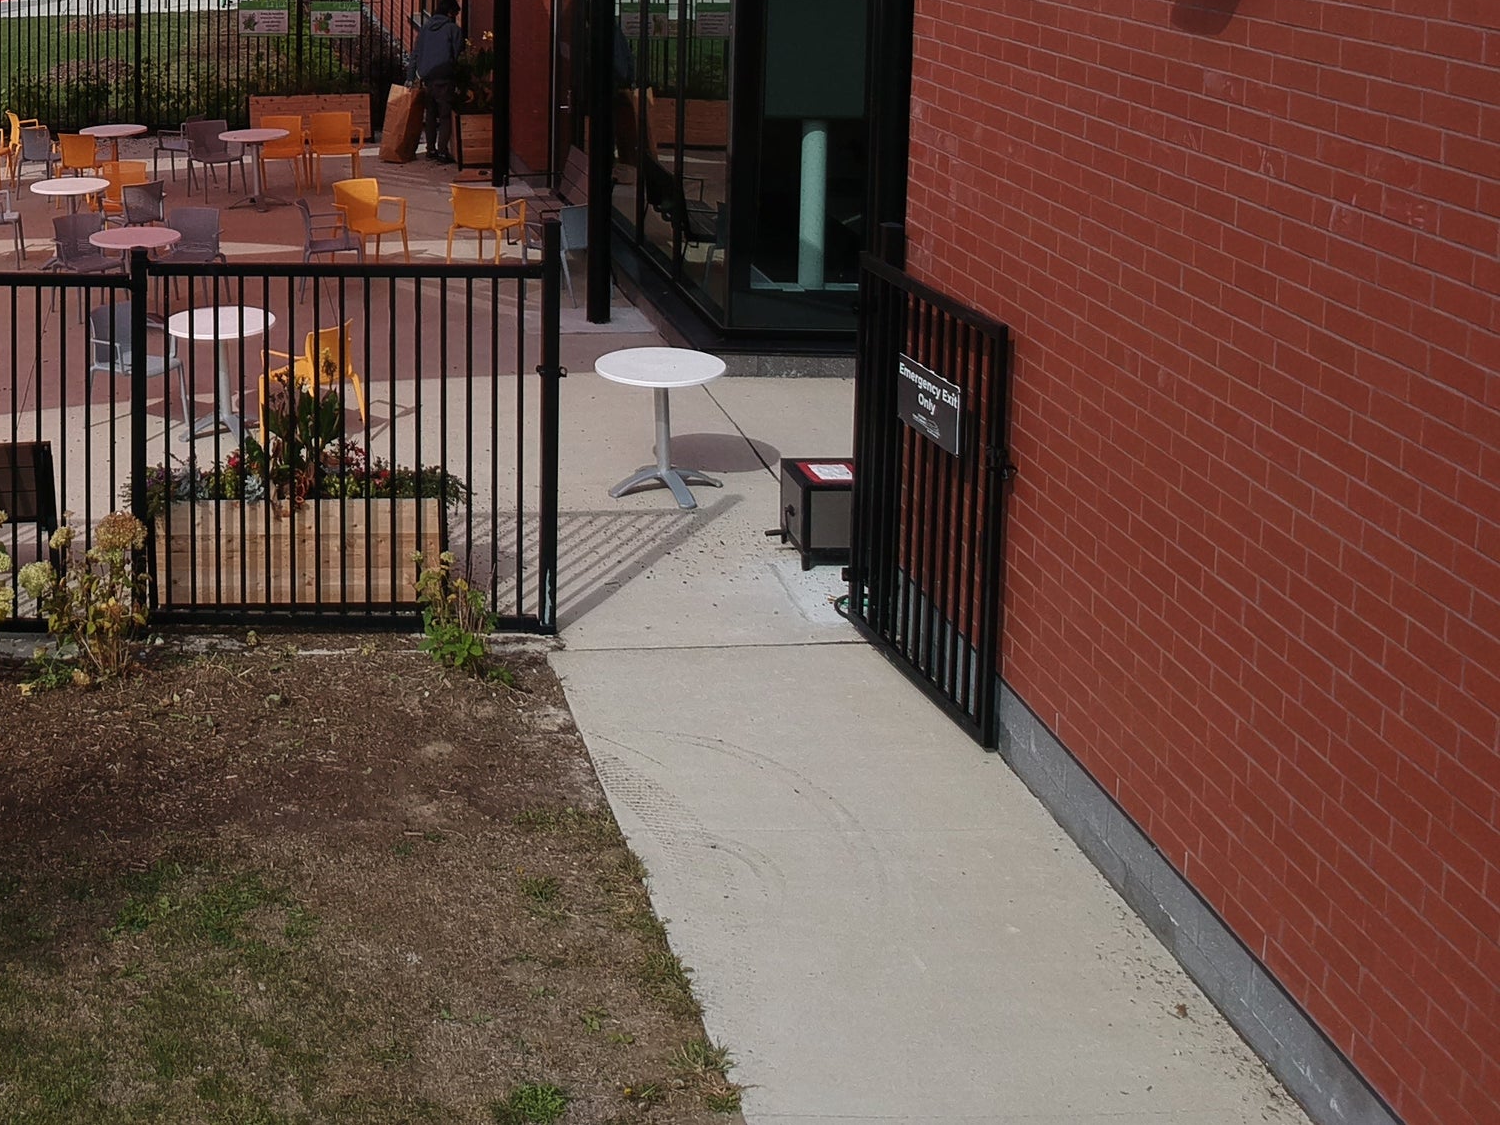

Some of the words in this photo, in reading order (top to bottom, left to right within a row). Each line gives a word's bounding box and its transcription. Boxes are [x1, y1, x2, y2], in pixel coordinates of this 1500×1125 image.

[899, 361, 941, 400] Emergency
[942, 388, 958, 409] Exit
[918, 393, 936, 416] Only
